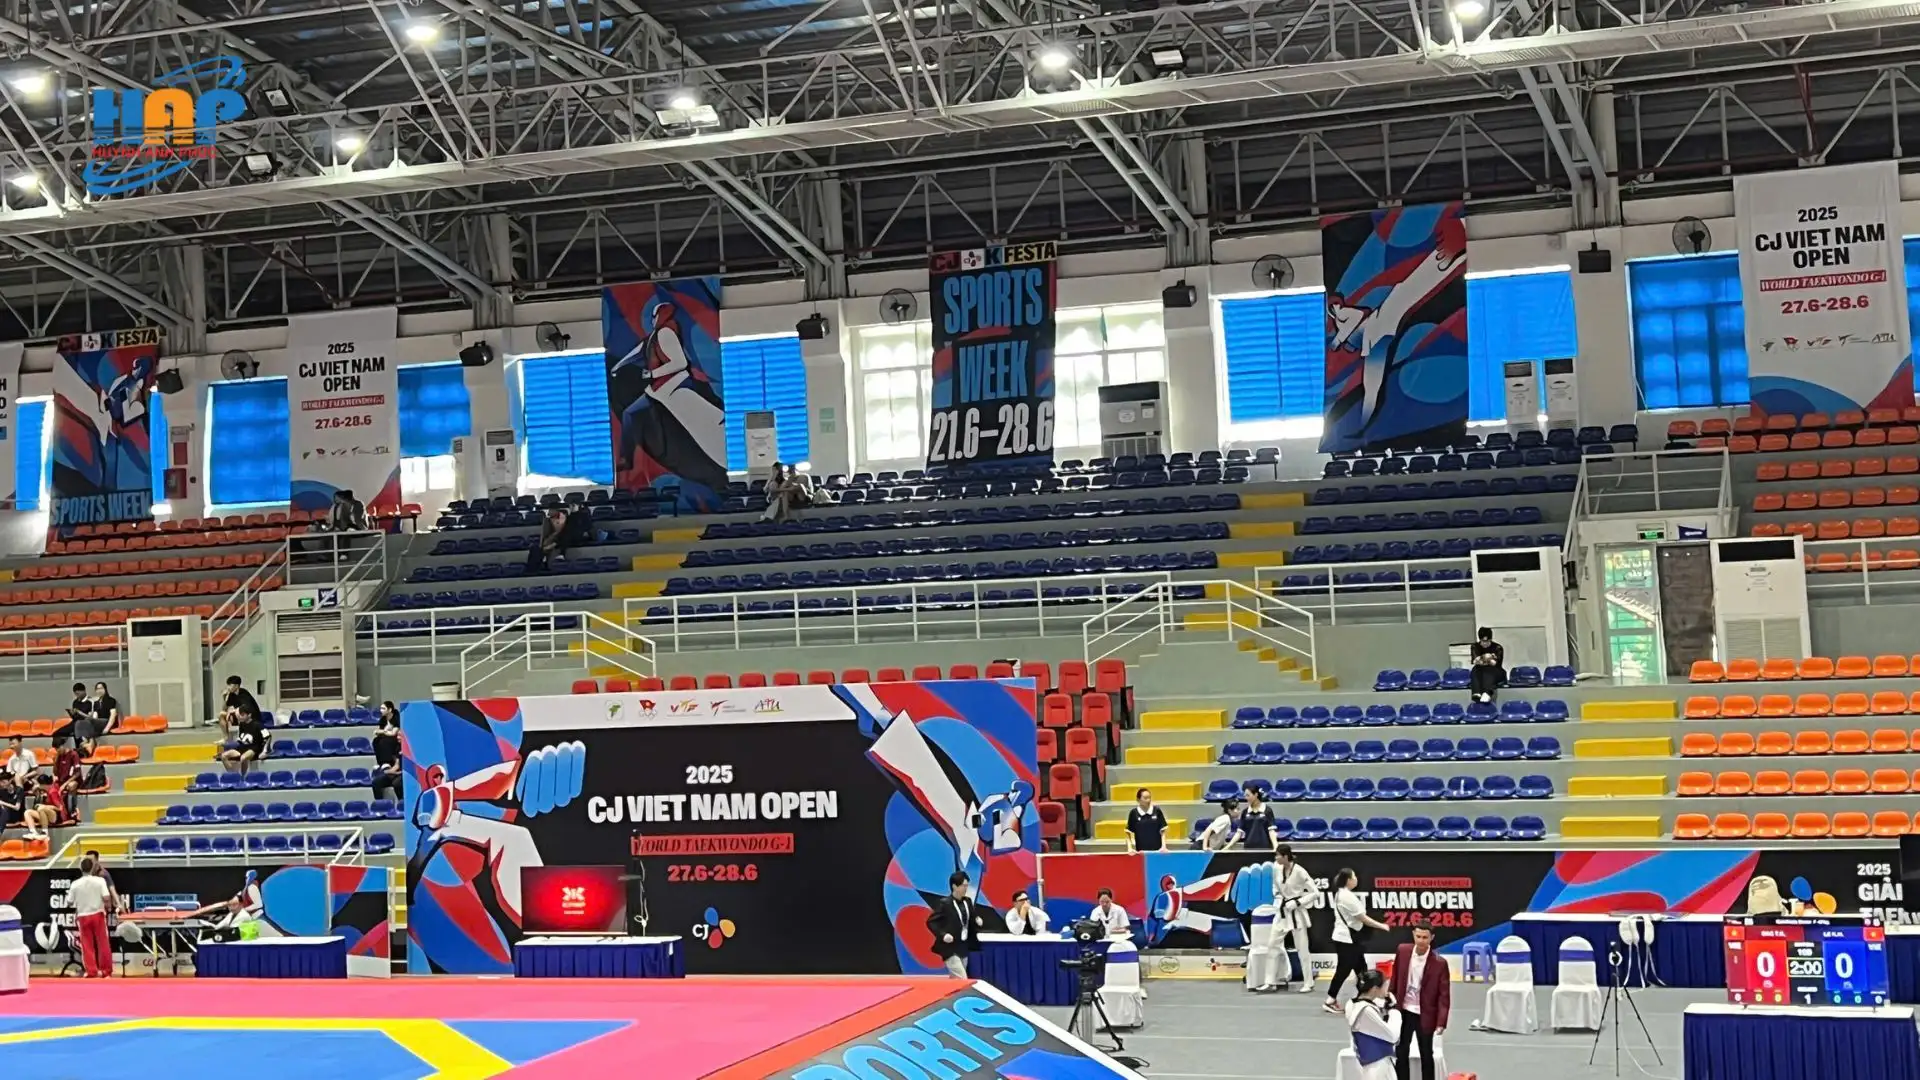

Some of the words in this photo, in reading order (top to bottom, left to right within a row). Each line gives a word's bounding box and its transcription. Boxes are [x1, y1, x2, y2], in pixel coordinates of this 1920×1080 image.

[1798, 206, 1838, 222] 2025
[1755, 232, 1782, 251] CJ
[1785, 228, 1831, 249] VIET
[1834, 223, 1885, 244] NAM
[936, 251, 958, 268] CJ
[988, 246, 1003, 264] K
[1004, 242, 1056, 263] FESTA
[1793, 247, 1850, 268] OPEN
[1761, 279, 1800, 291] WORLD
[1801, 273, 1869, 288] TAEKWONDO
[943, 268, 1043, 334] SPORTS
[1781, 295, 1870, 314] 27.6-28.6
[116, 331, 157, 346] FESTA
[328, 342, 354, 355] 2025
[299, 363, 316, 378] CJ
[319, 360, 349, 376] VIET
[351, 357, 385, 373] NAM
[959, 340, 1028, 403] WEEK
[323, 376, 361, 392] OPEN
[315, 415, 372, 429] 27.6-28.6
[51, 495, 105, 525] SPORTS
[686, 765, 733, 784] 2025
[587, 796, 623, 823] CJ
[627, 794, 686, 822] VIET
[691, 792, 756, 820] NAM
[761, 790, 838, 819] OPEN
[634, 837, 680, 854] WORLD
[684, 836, 769, 852] TAEKWONDO
[770, 836, 791, 850] G-1
[667, 863, 758, 882] 27.6-28.6
[1857, 863, 1891, 875] 2025
[1858, 876, 1903, 901] GIẢI
[1371, 891, 1418, 909] NAM
[1420, 891, 1473, 909] OPEN
[692, 923, 709, 940] CJ
[1757, 951, 1775, 978] 0
[1789, 961, 1822, 976] 2:00
[1835, 953, 1853, 979] 0
[1804, 994, 1811, 1004] 1
